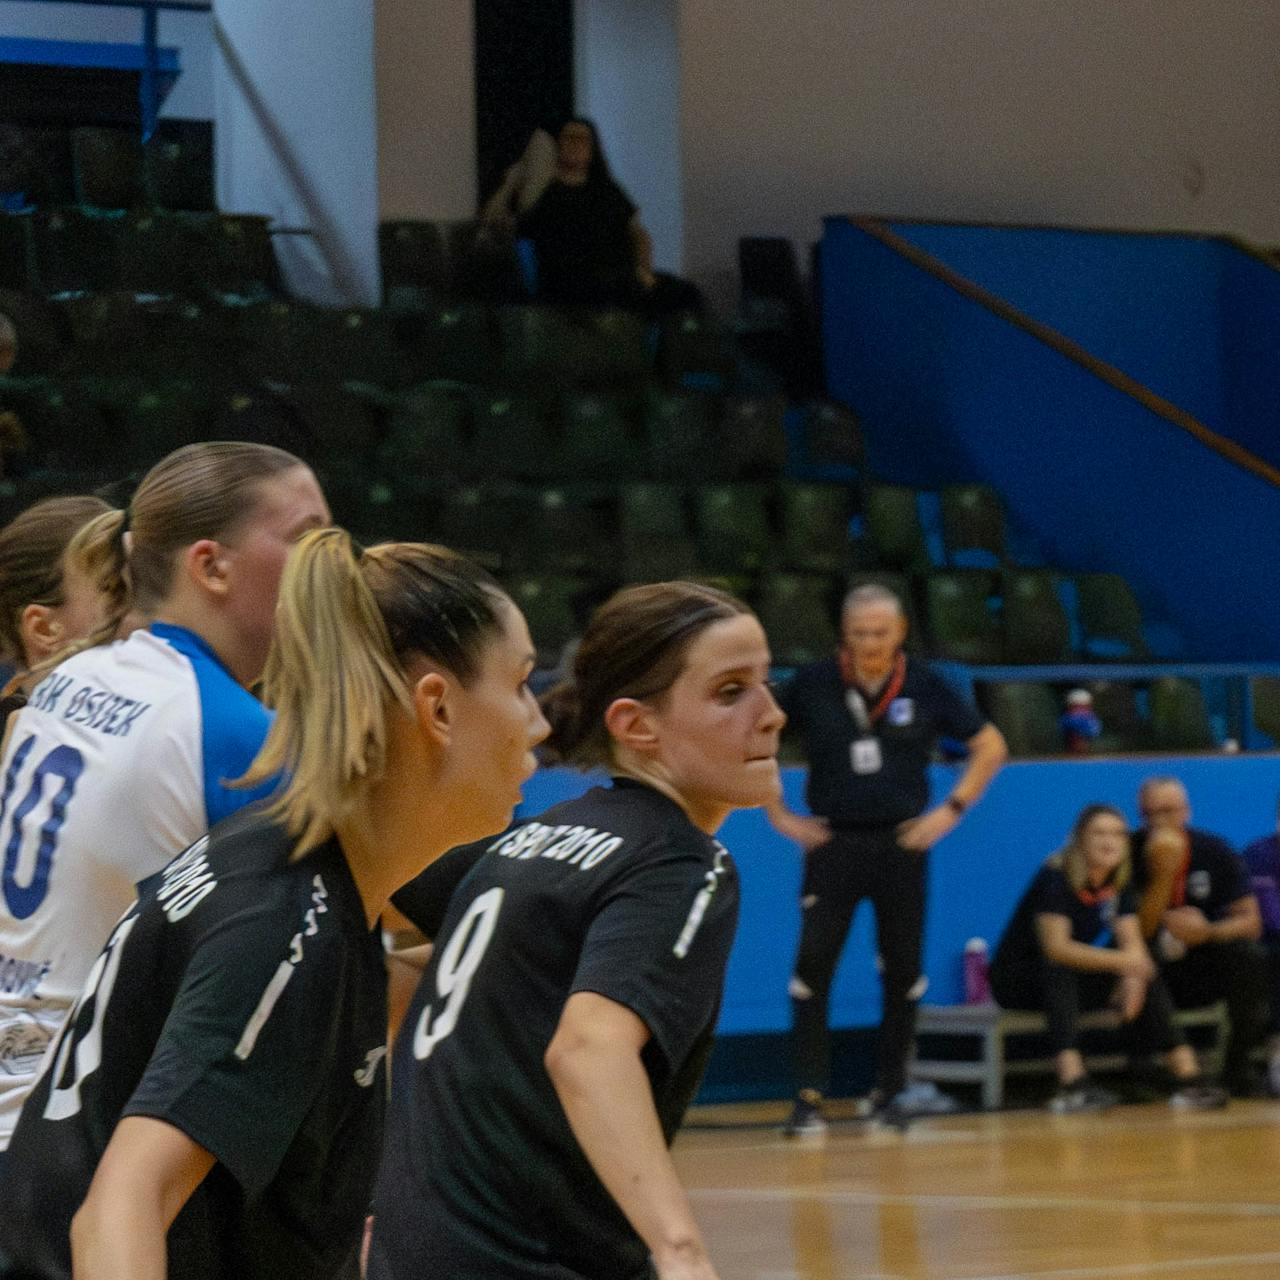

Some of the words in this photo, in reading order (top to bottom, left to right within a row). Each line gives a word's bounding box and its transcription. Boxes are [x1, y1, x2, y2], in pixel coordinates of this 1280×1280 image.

[30, 671, 74, 713] RK
[64, 686, 152, 736] OSIJEK
[541, 825, 624, 871] 2010
[413, 886, 505, 1060] 9
